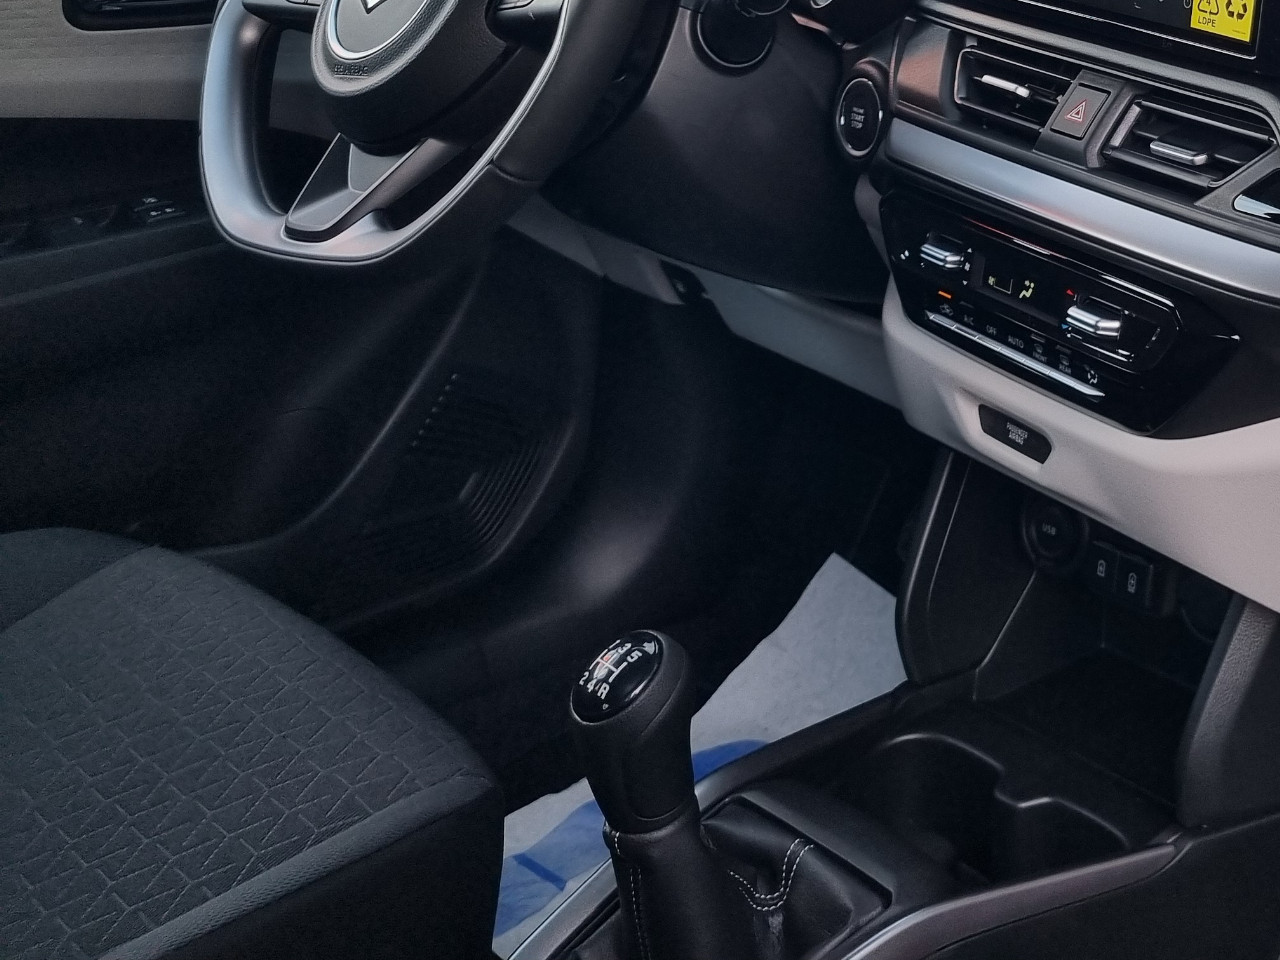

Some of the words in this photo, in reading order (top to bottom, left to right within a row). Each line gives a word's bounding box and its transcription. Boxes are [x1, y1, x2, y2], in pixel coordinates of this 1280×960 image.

[1197, 15, 1217, 28] LDPE
[986, 325, 997, 336] OFF
[1008, 335, 1024, 349] AUTO
[626, 649, 643, 662] 5
[579, 671, 589, 685] 2
[587, 679, 598, 693] 4
